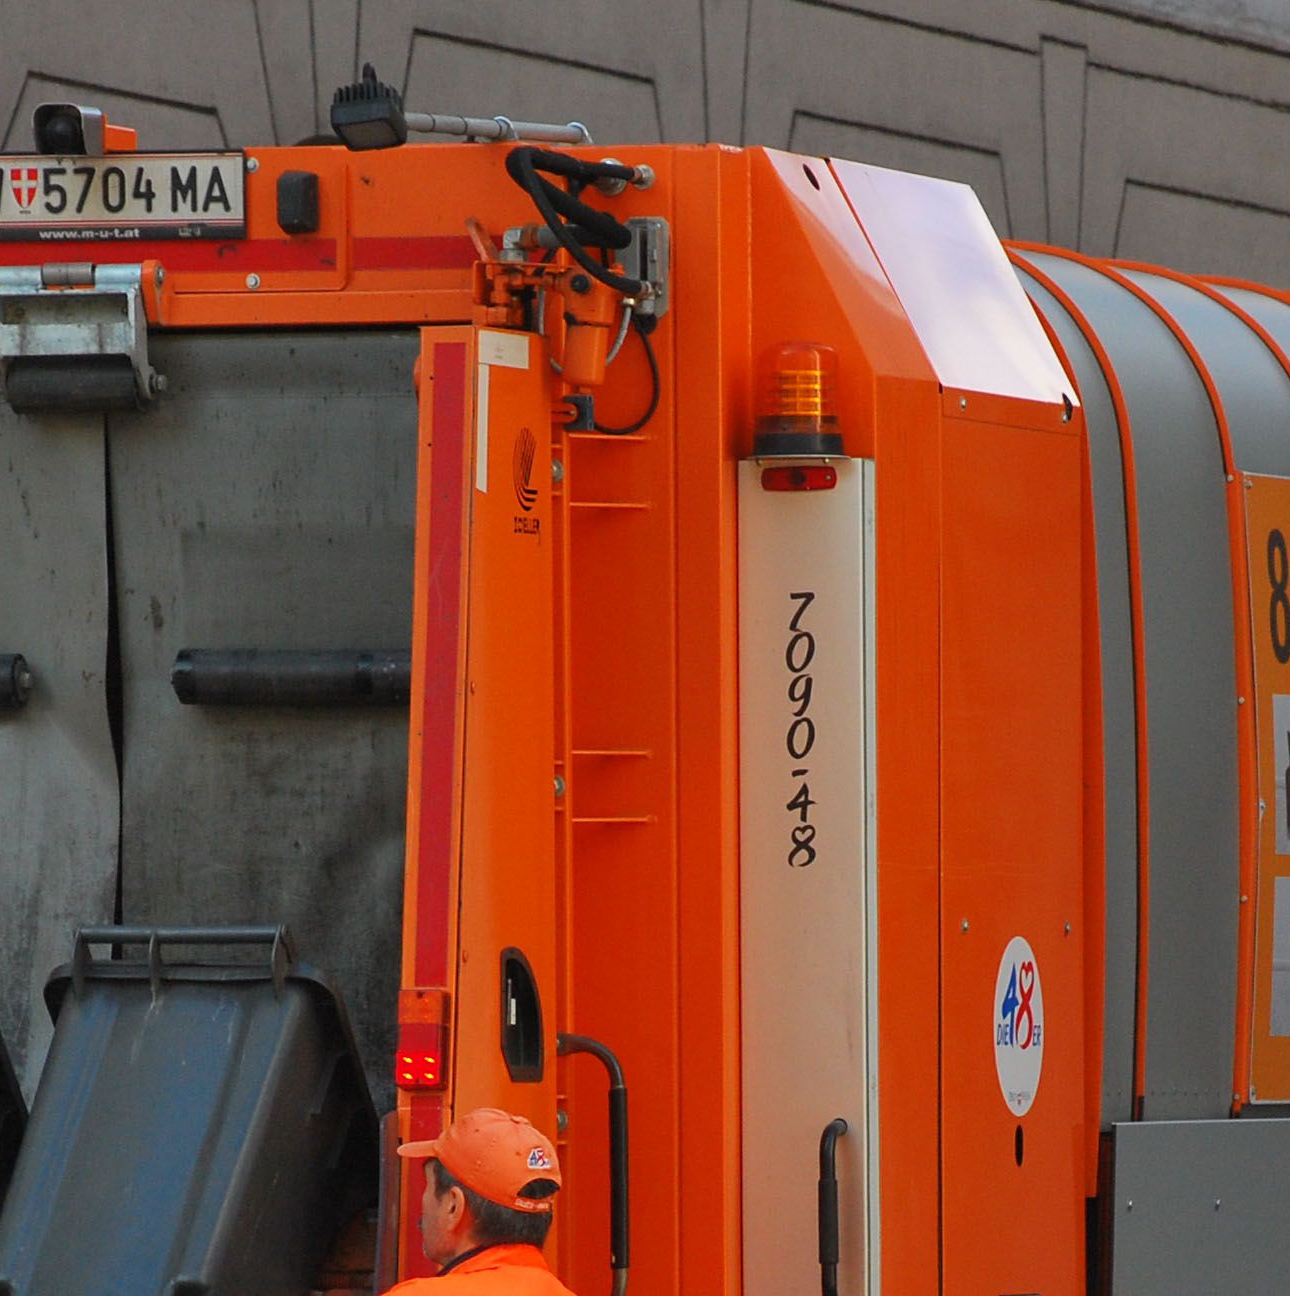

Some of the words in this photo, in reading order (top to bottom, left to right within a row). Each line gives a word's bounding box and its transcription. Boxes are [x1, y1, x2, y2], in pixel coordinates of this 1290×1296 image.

[42, 165, 156, 215] 5704
[170, 165, 232, 214] MA
[38, 227, 141, 240] www.m-u-t.at
[785, 591, 818, 868] 7090-48
